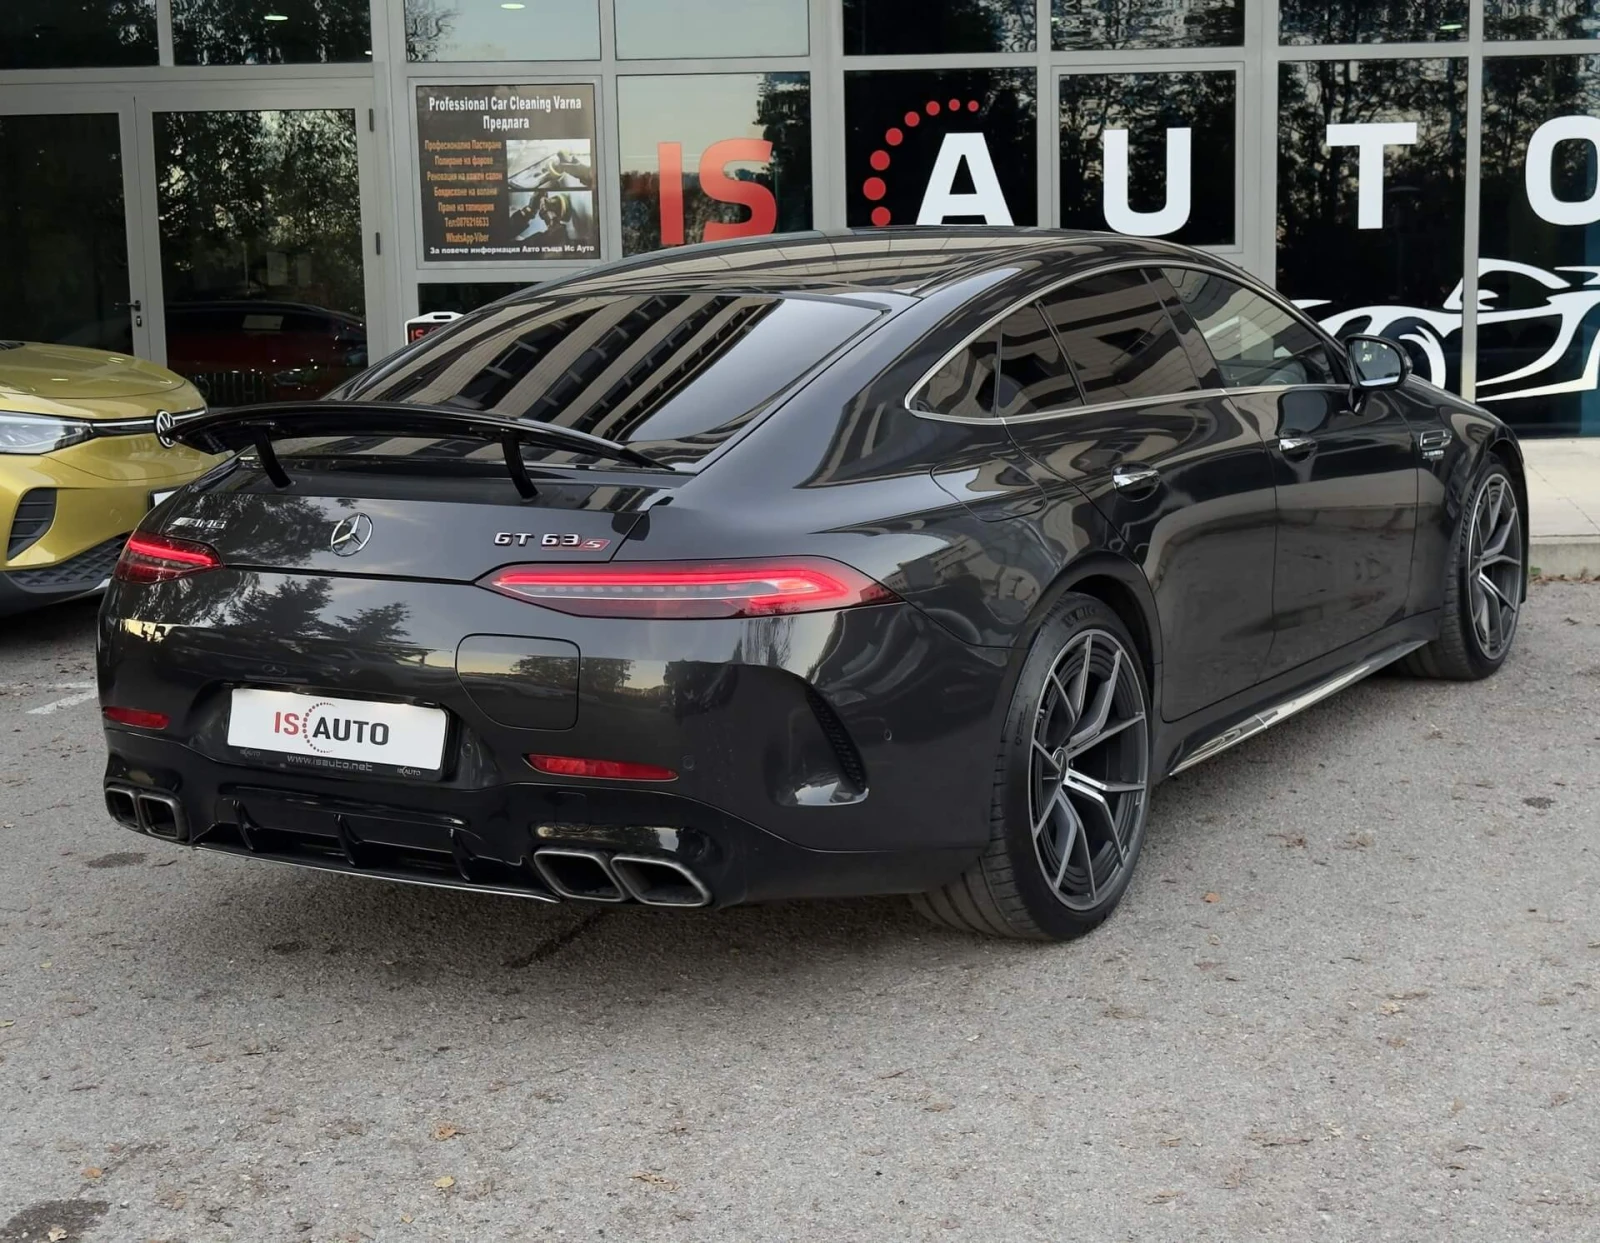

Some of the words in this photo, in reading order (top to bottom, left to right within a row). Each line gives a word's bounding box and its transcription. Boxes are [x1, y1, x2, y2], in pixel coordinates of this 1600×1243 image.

[429, 96, 488, 111] Professional
[491, 97, 508, 110] Car
[509, 96, 552, 113] Cleaning
[553, 95, 582, 109] Varna
[483, 115, 530, 132] Предлага
[463, 157, 471, 165] на
[468, 188, 476, 196] на
[657, 138, 777, 245] IS
[470, 246, 521, 255] информация
[522, 245, 540, 253] Авто
[541, 246, 563, 254] къща
[577, 244, 595, 253] Ауто
[186, 518, 227, 529] AMG
[494, 532, 535, 547] GT
[274, 711, 300, 736] IS
[312, 717, 390, 746] AUTO
[286, 754, 373, 772] www.isauto.net
